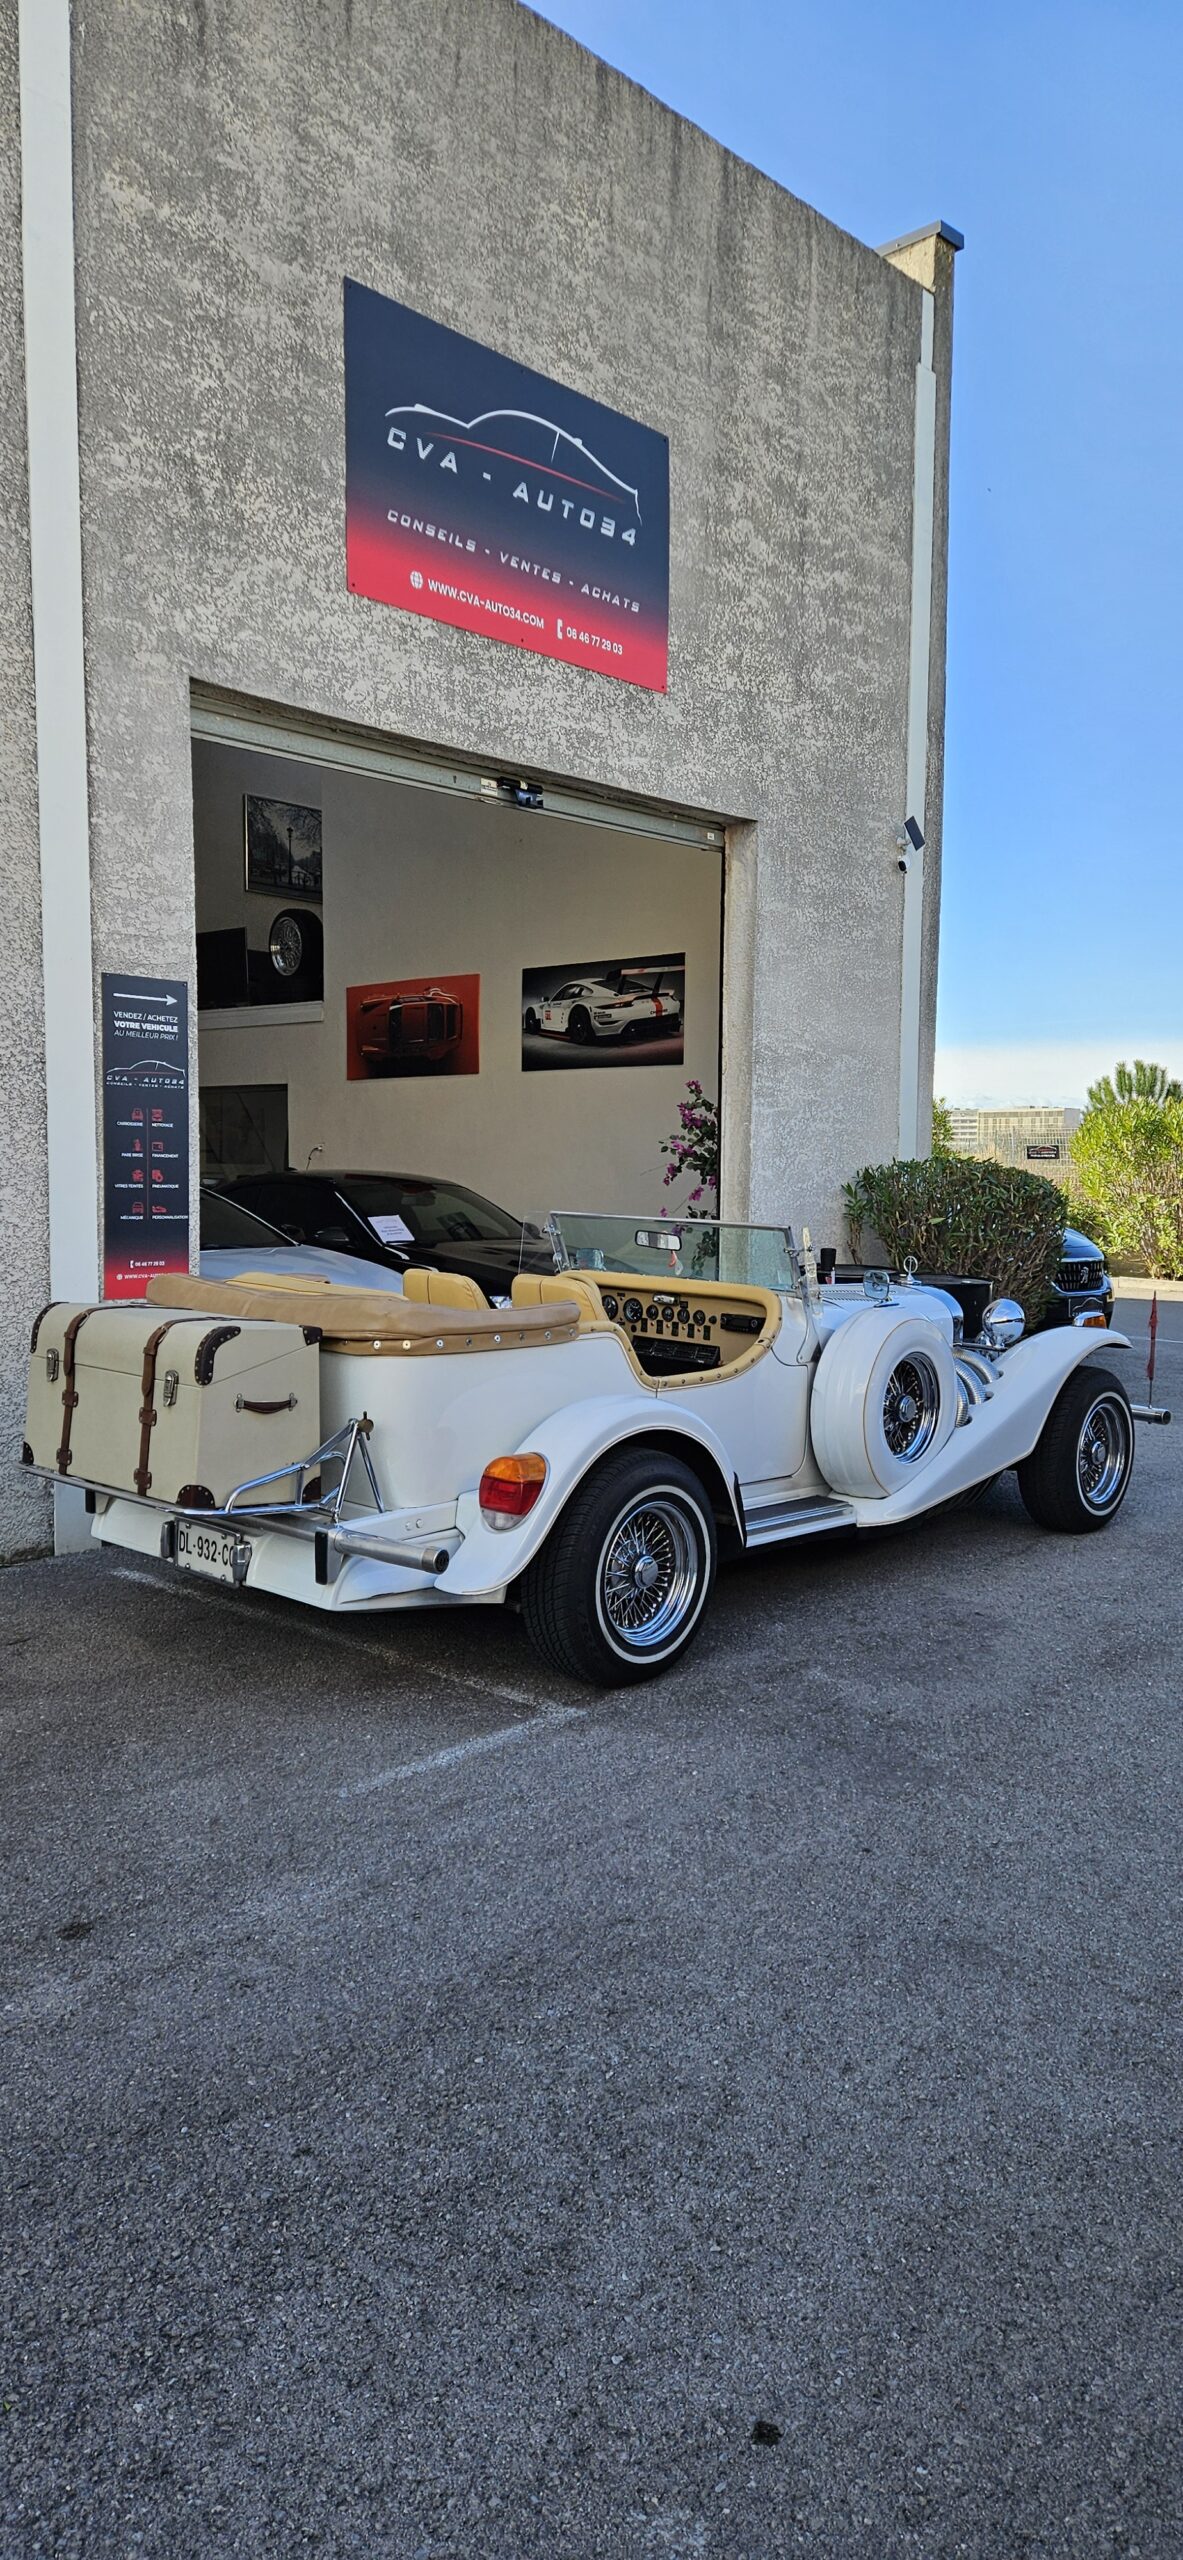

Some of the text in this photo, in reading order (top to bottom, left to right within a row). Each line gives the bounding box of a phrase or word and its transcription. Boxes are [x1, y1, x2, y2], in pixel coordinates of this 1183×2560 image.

[387, 427, 457, 474] CVA
[513, 482, 636, 546] AUTO34
[387, 509, 476, 552] CONSEILS
[500, 551, 561, 584] VENTES
[581, 584, 640, 613] ACHATS
[428, 578, 545, 629] WWW.CVA-AUTO34.COM
[579, 631, 590, 644] 46
[591, 635, 600, 648] 77
[601, 638, 611, 651] 29
[612, 642, 623, 655] 03
[113, 1011, 142, 1020] VENDEZ
[147, 1014, 178, 1023] ACHETEZ
[114, 1020, 140, 1029] VOTRE
[114, 1029, 124, 1037] AU
[126, 1031, 159, 1039] MEILLEUR
